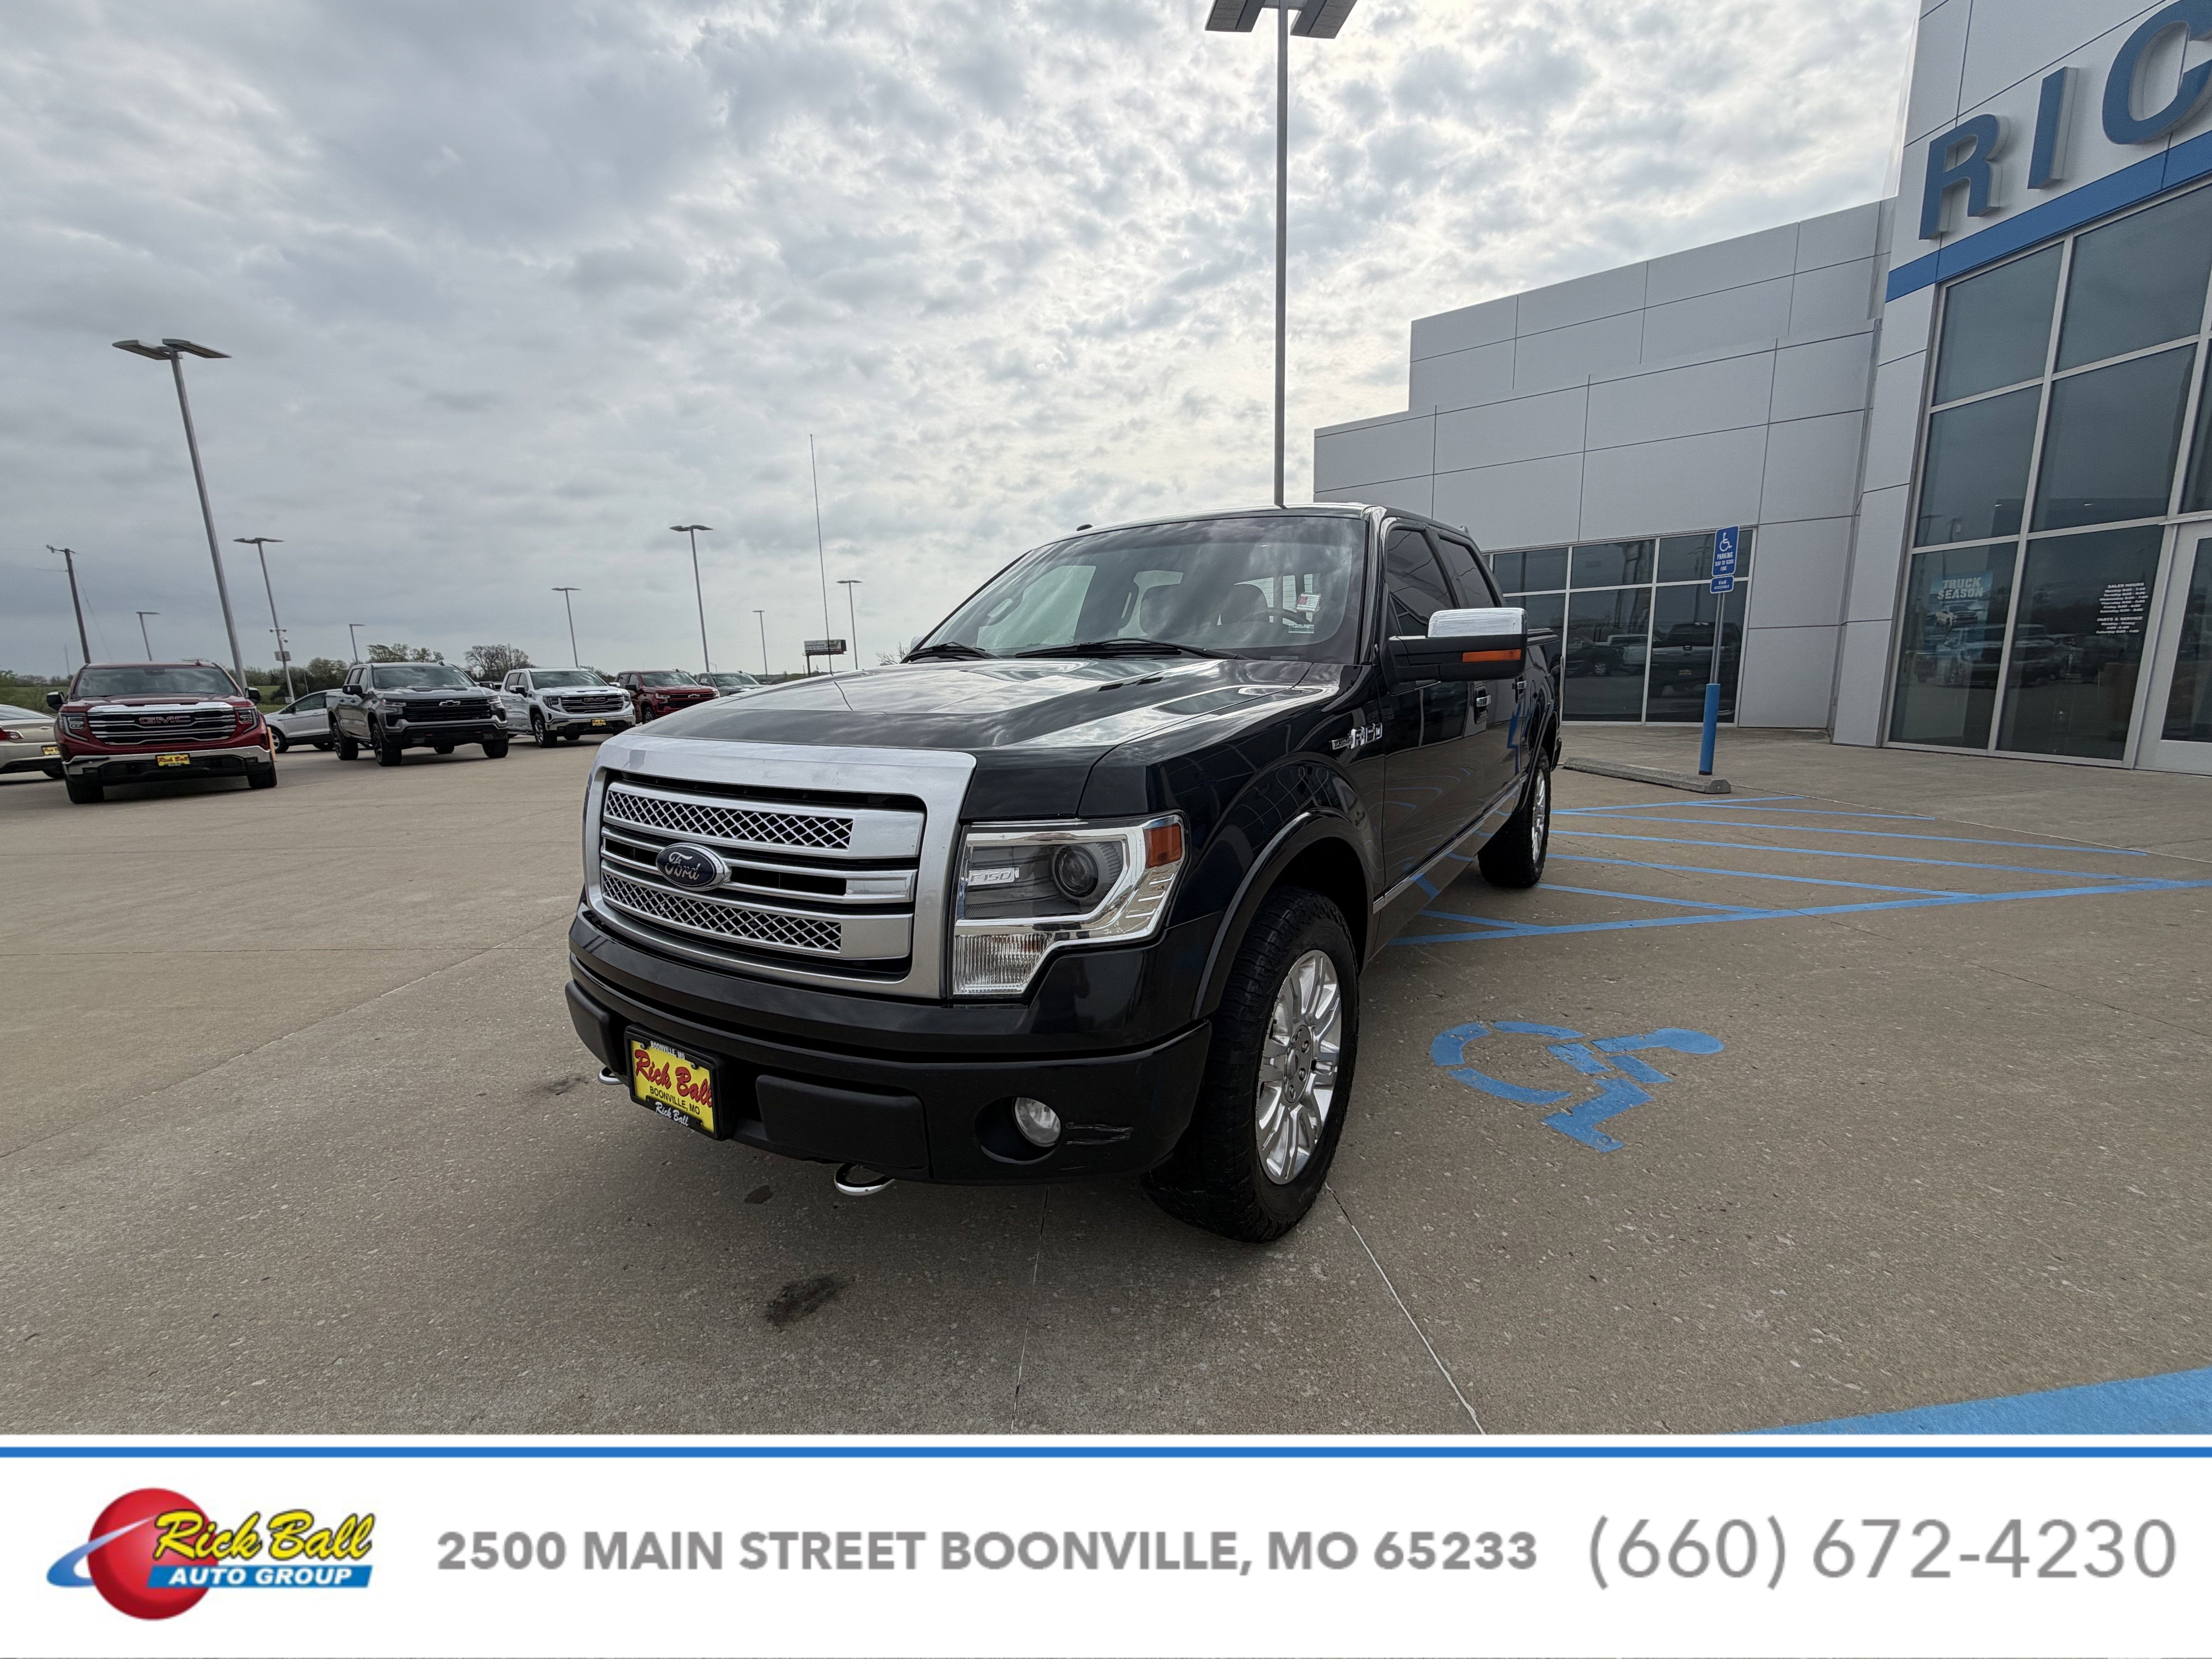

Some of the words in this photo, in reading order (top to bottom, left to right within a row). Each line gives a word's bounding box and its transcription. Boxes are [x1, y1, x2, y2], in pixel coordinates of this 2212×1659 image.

[1717, 552, 1733, 560] PARKING
[1942, 577, 1981, 589] TRUCK
[1937, 587, 1984, 599] SEASON
[139, 715, 191, 724] GMC
[665, 852, 701, 880] Ford
[650, 1041, 677, 1057] BOONVILLE,
[677, 1051, 685, 1060] MO
[634, 1049, 672, 1090] Rick
[675, 1066, 713, 1108] Ball
[649, 1085, 688, 1111] BOONVILLE,
[689, 1103, 700, 1115] MO
[655, 1101, 672, 1118] Rick
[673, 1109, 689, 1127] Ball
